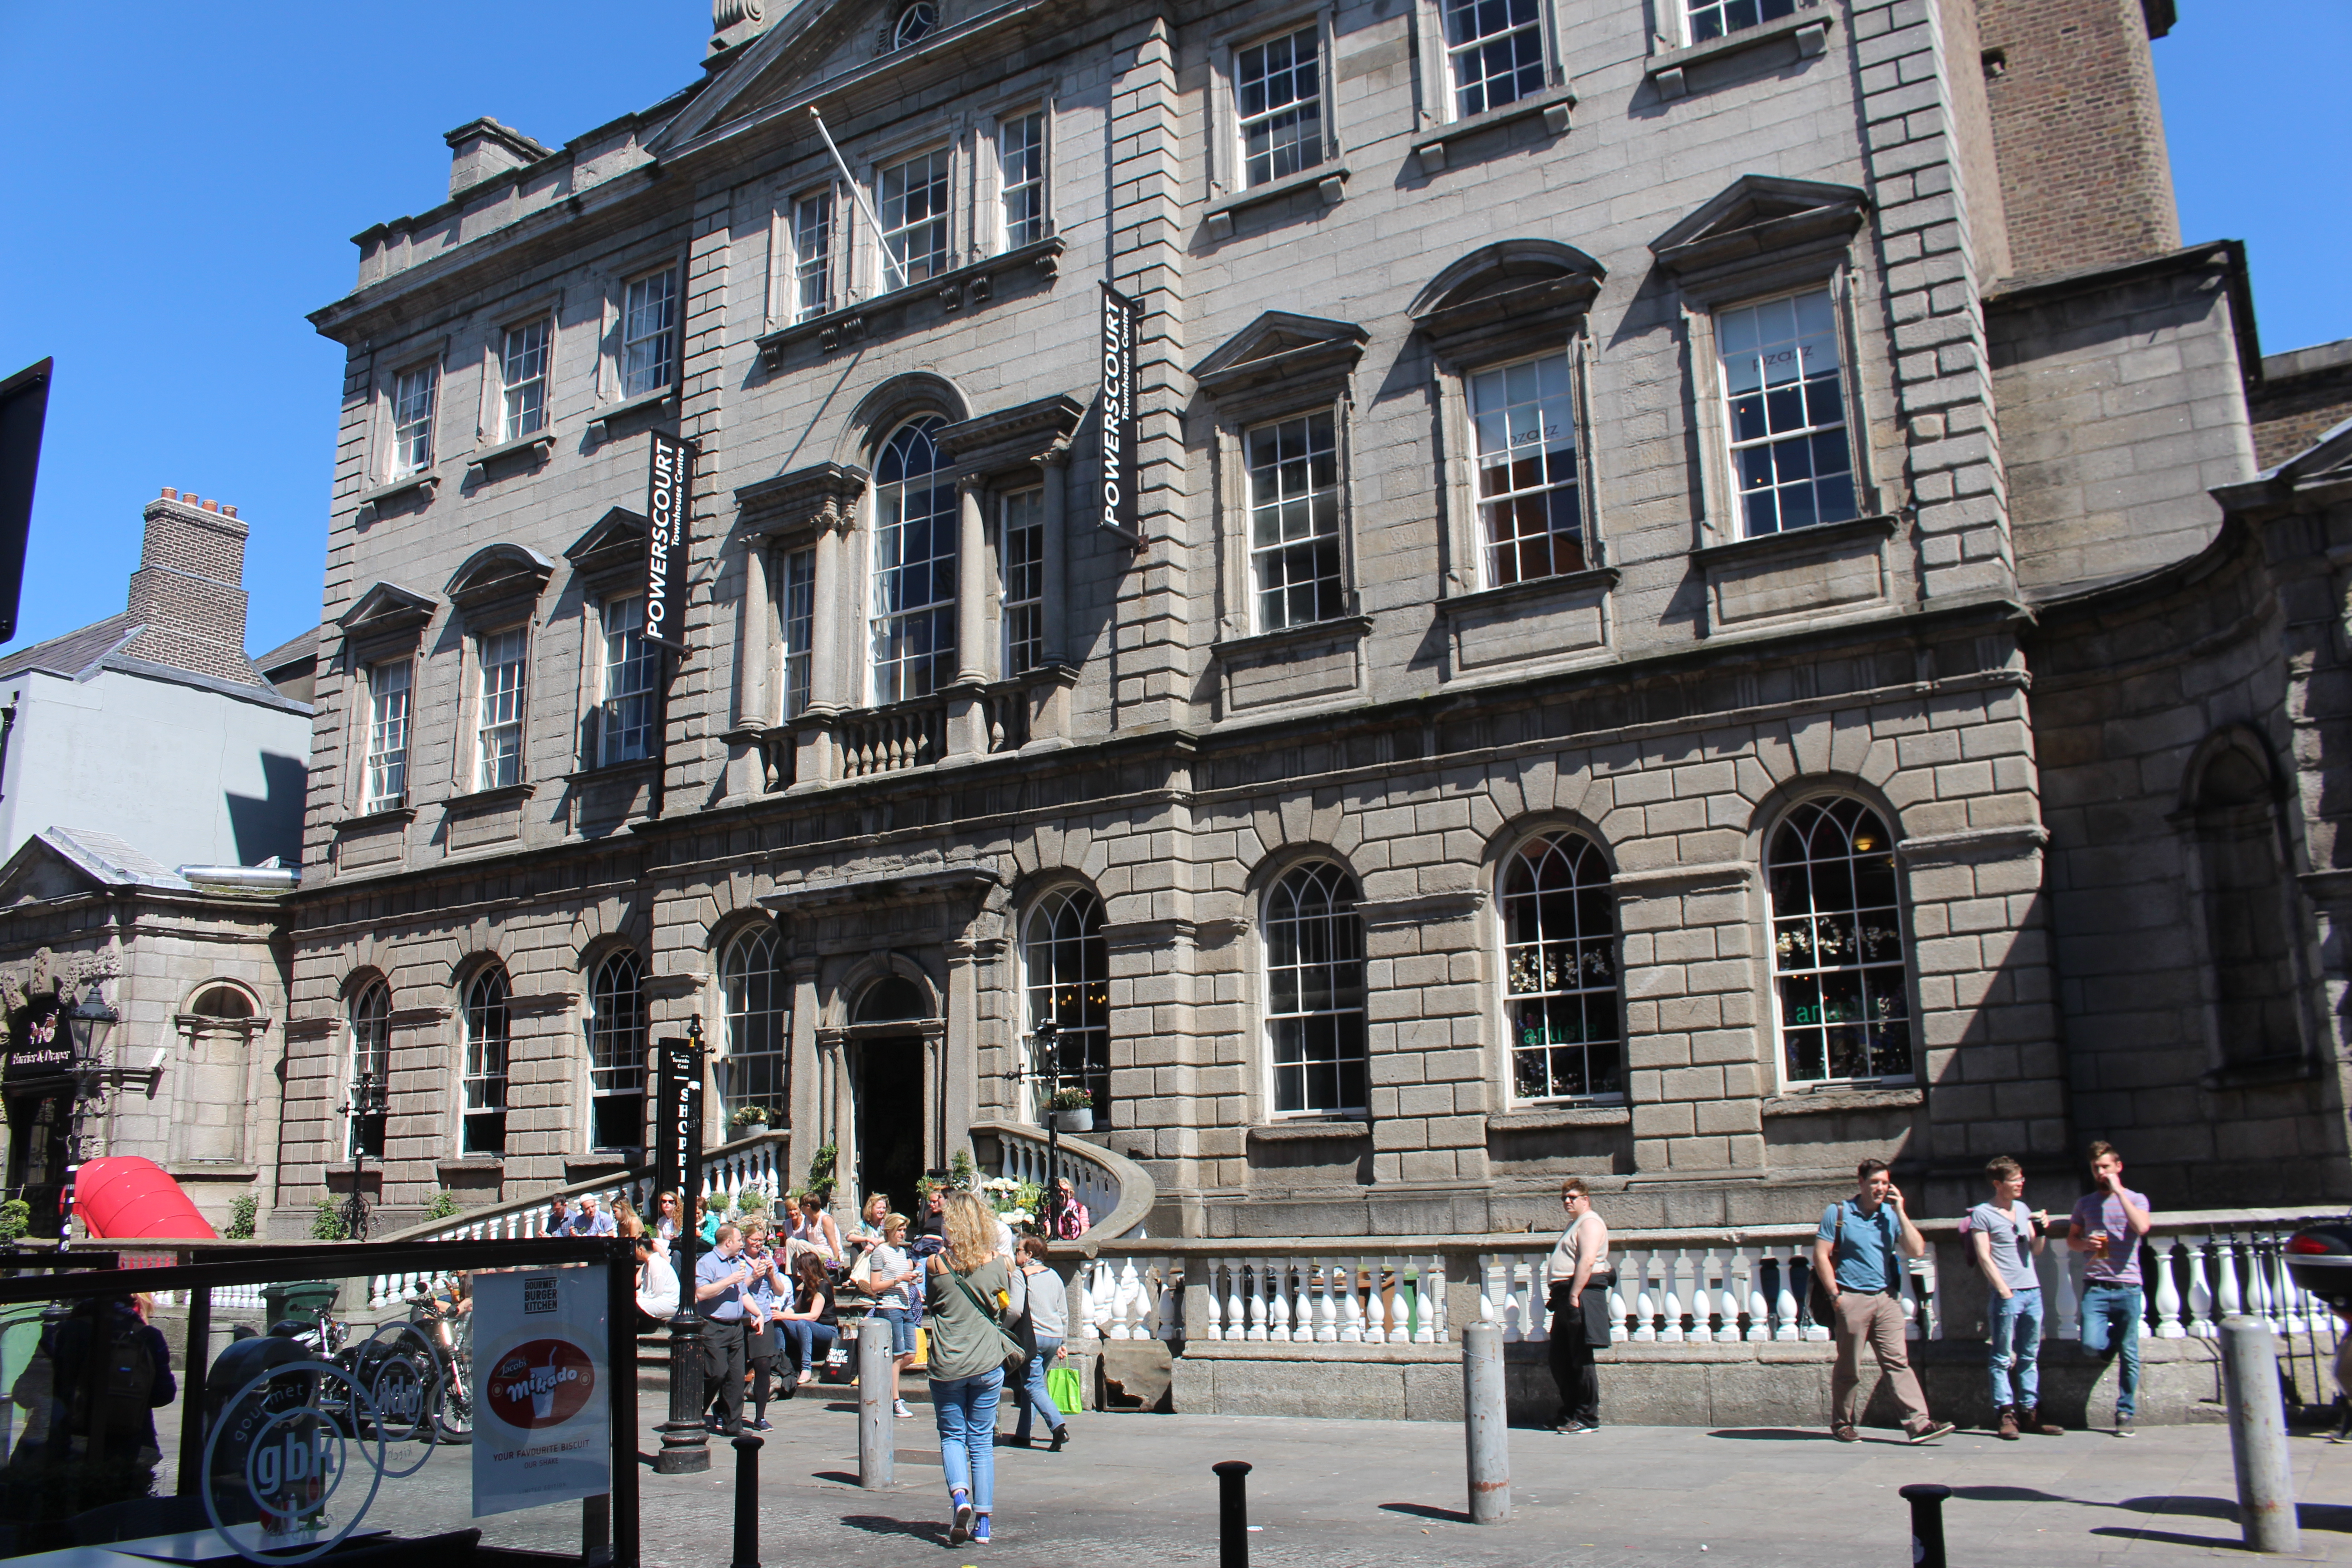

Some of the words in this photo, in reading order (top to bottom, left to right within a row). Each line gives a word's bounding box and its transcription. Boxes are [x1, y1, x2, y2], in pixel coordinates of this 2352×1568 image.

[1753, 346, 1813, 372] pzaz
[1104, 294, 1120, 527] POWERSCOURT
[675, 447, 685, 482] Centre
[671, 486, 682, 547] Townhouse
[647, 438, 673, 639] POWERSCOURT
[1796, 996, 1877, 1023] artic
[1524, 1019, 1596, 1043] article
[44, 1049, 71, 1064] Draper
[677, 1088, 689, 1199] SHOPPIN
[524, 1279, 557, 1290] GOURMET
[524, 1289, 557, 1301] BURGER
[524, 1299, 557, 1312] KITCHEN
[826, 1355, 848, 1363] ONLINE
[257, 1429, 336, 1495] gbk
[493, 1453, 514, 1462] YOUR
[517, 1445, 558, 1458] FAVOURITE
[561, 1439, 590, 1451] BISCUIT
[524, 1461, 537, 1469] OUR
[539, 1457, 559, 1467] SHAKE
[519, 1486, 541, 1494] LIMITED
[544, 1482, 566, 1491] EDITION
